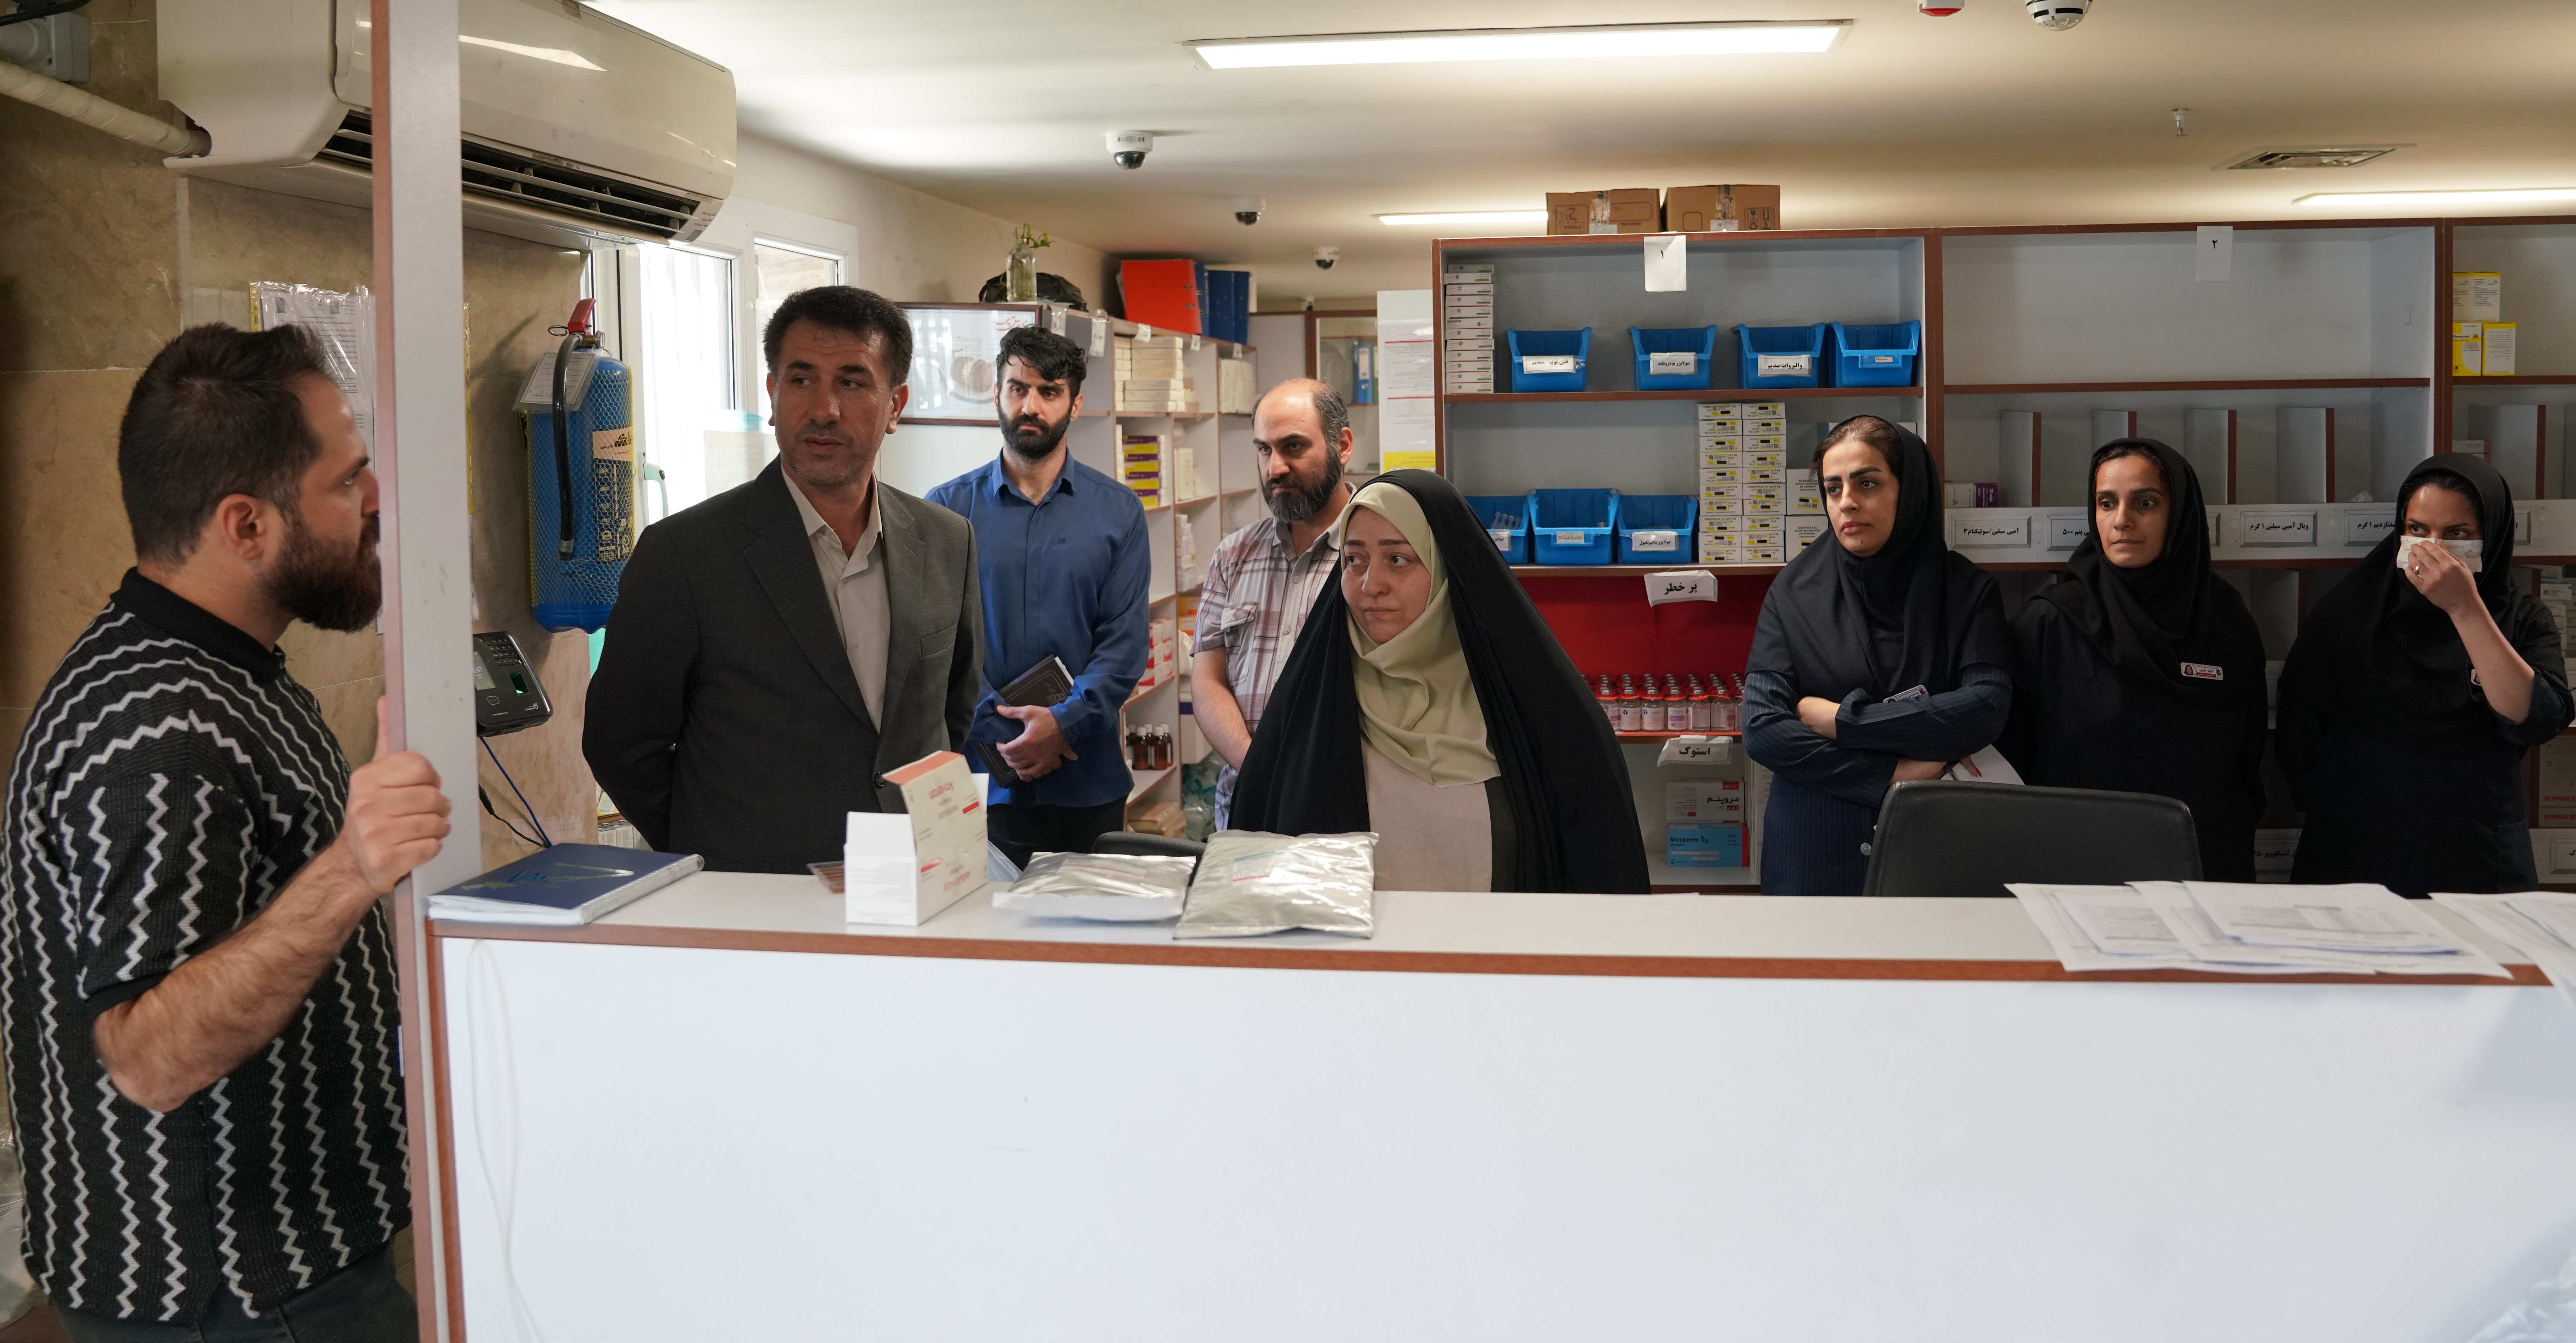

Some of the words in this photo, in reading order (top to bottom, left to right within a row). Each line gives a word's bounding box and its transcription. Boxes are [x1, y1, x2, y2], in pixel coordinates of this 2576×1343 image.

[2212, 239, 2218, 249] ۲
[1660, 250, 1664, 259] ۱
[2250, 523, 2261, 531] گرم
[1664, 582, 1685, 595] خطر
[1688, 582, 1698, 595] پر
[1679, 746, 1711, 758] استوک
[1707, 796, 1739, 804] مروپنم
